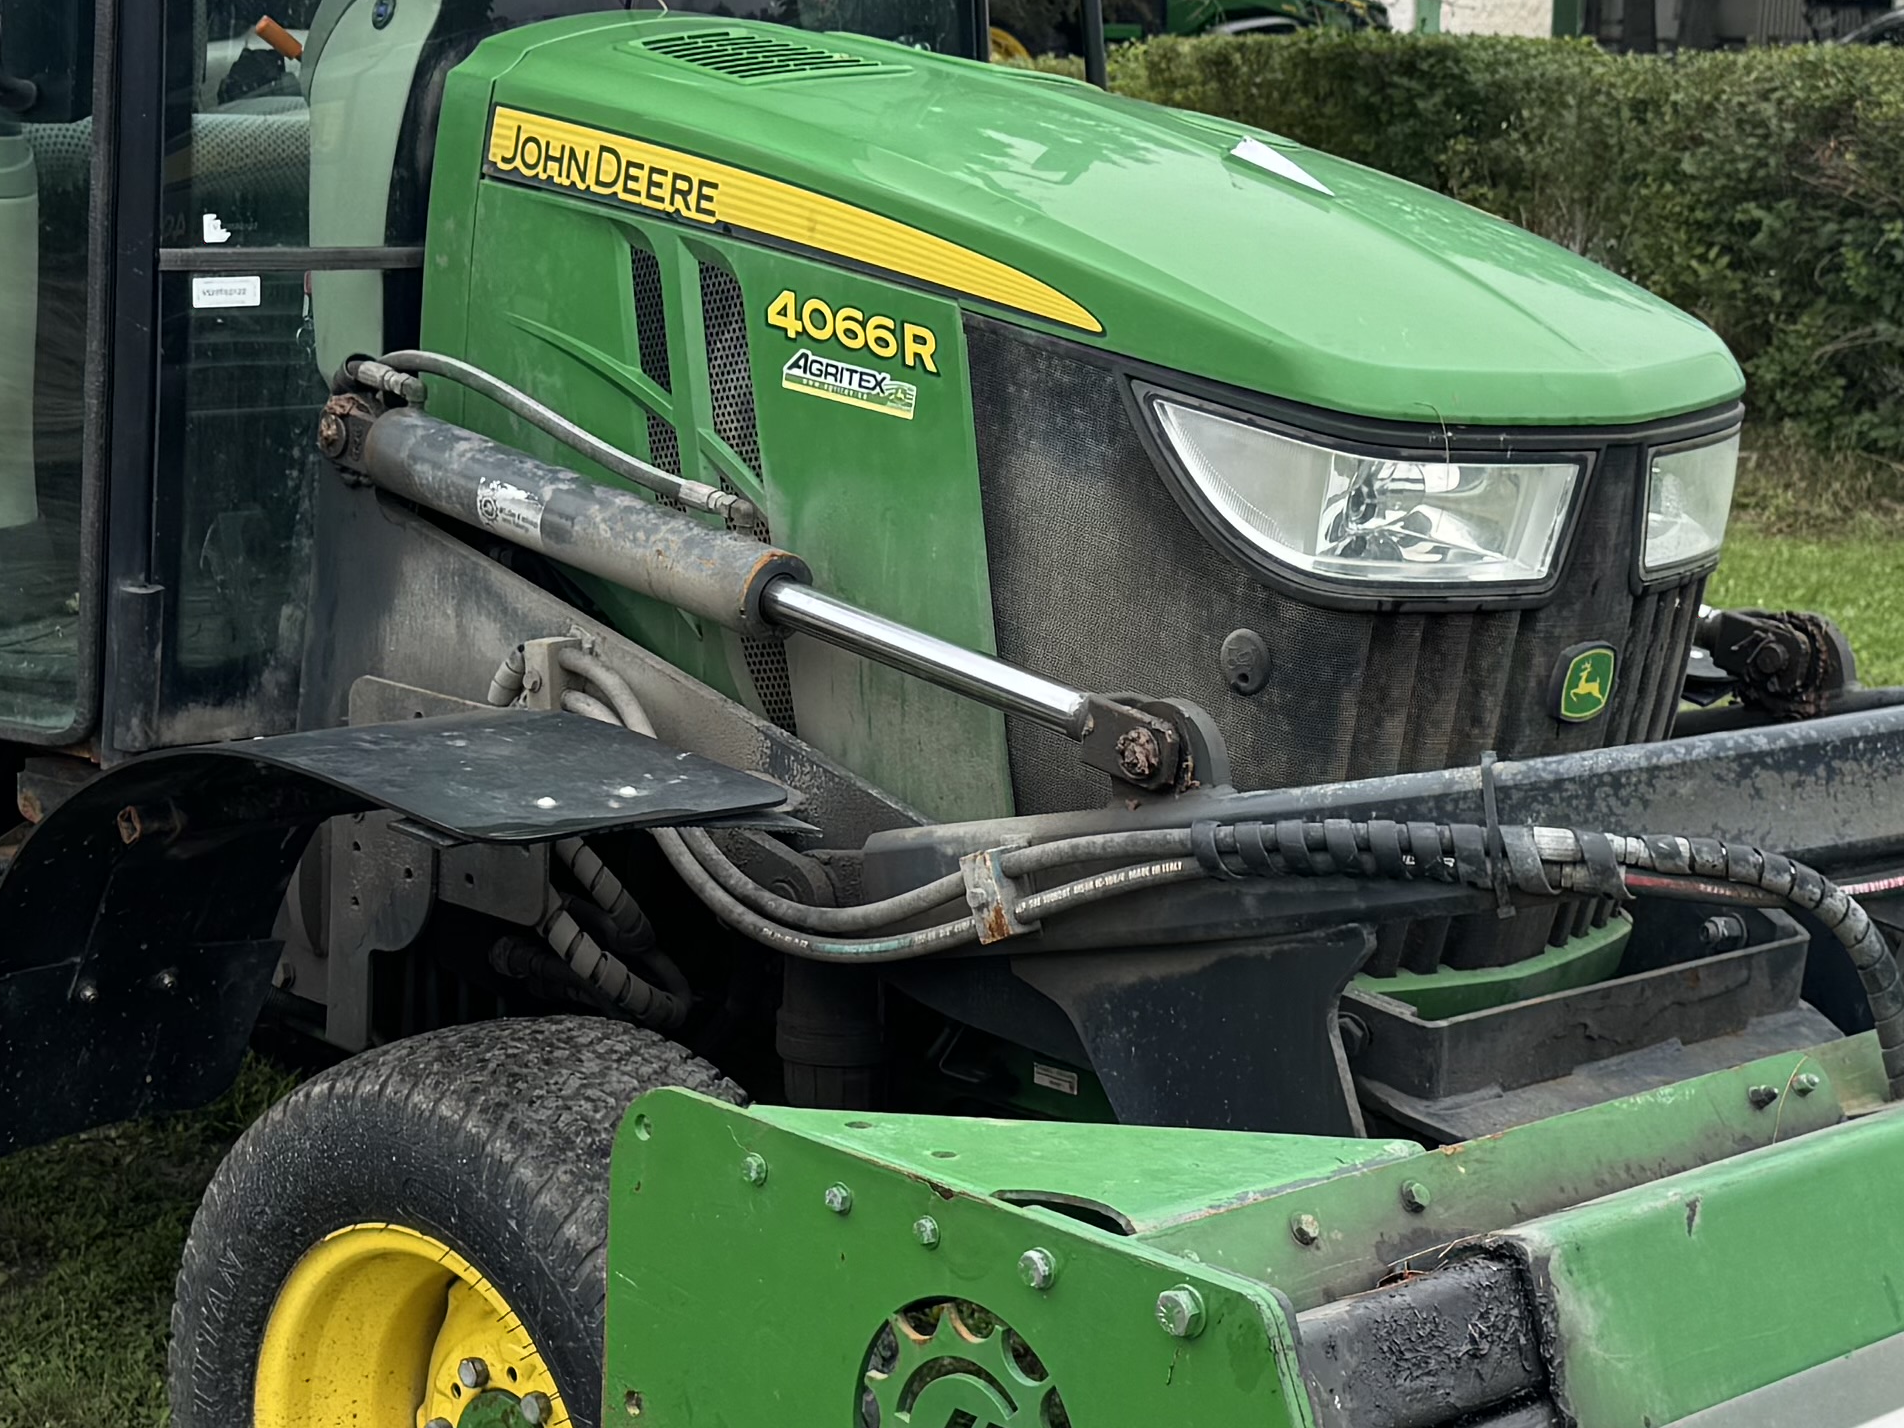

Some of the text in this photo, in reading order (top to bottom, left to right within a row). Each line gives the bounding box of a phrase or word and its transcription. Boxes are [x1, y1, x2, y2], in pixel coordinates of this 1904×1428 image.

[502, 124, 720, 219] JOHN DEERE
[767, 290, 939, 374] 4066R
[787, 351, 888, 394] AGRITEX
